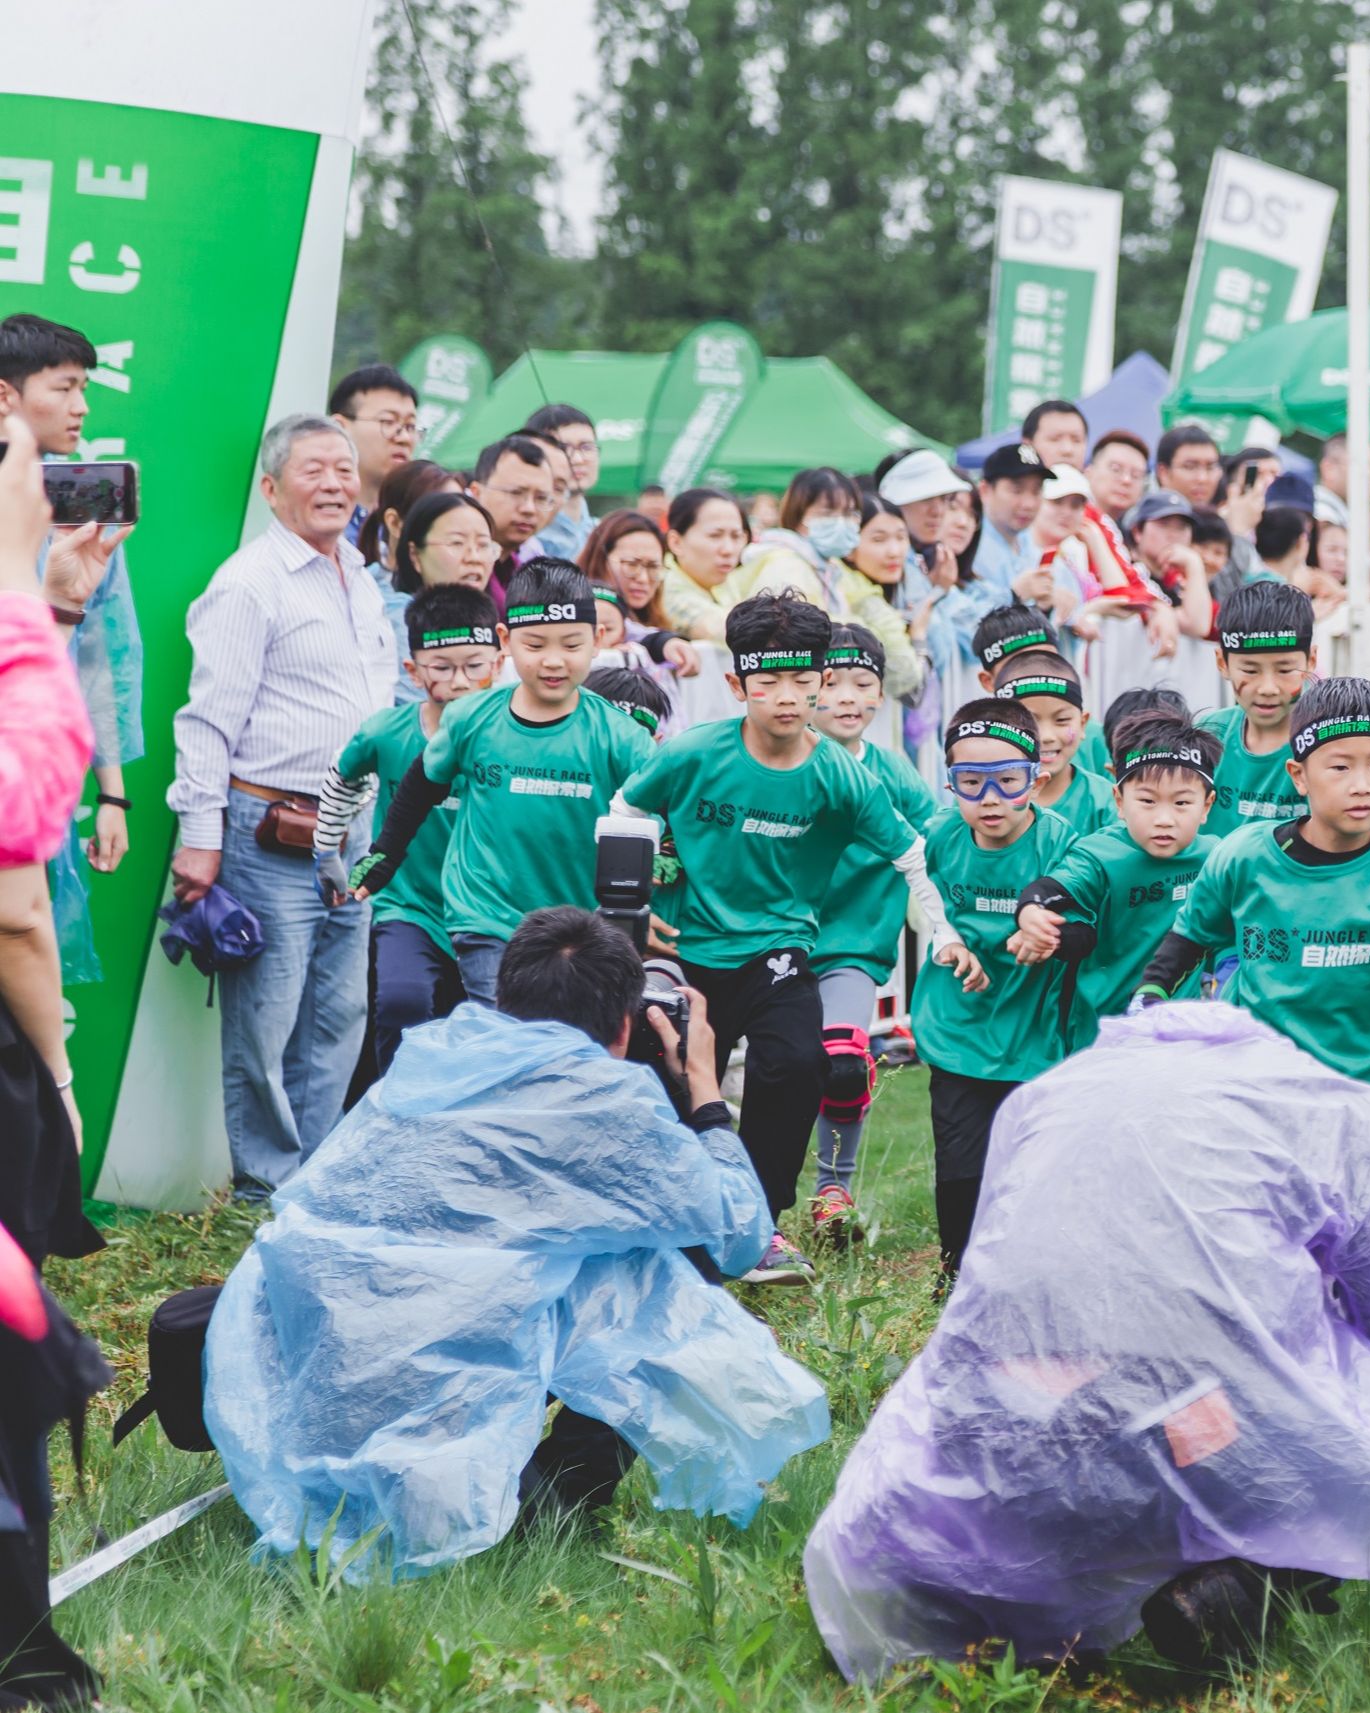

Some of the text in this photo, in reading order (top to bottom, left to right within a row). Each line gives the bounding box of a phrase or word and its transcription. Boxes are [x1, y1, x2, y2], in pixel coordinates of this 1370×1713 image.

[548, 604, 576, 621] DS
[473, 627, 493, 644] DS
[740, 653, 759, 670] DS
[958, 721, 985, 736] DS
[1296, 727, 1315, 754] DS
[1317, 715, 1354, 729] JUNGLE
[474, 761, 592, 788] DS JUNGLE RACE
[696, 799, 736, 827] DS
[744, 808, 788, 823] JUNGLE
[973, 886, 1016, 898] JUNGLE
[1129, 881, 1164, 908] DS
[1171, 871, 1199, 885] JUNG
[1243, 926, 1290, 963] DS
[1302, 930, 1366, 944] JUNGLE
